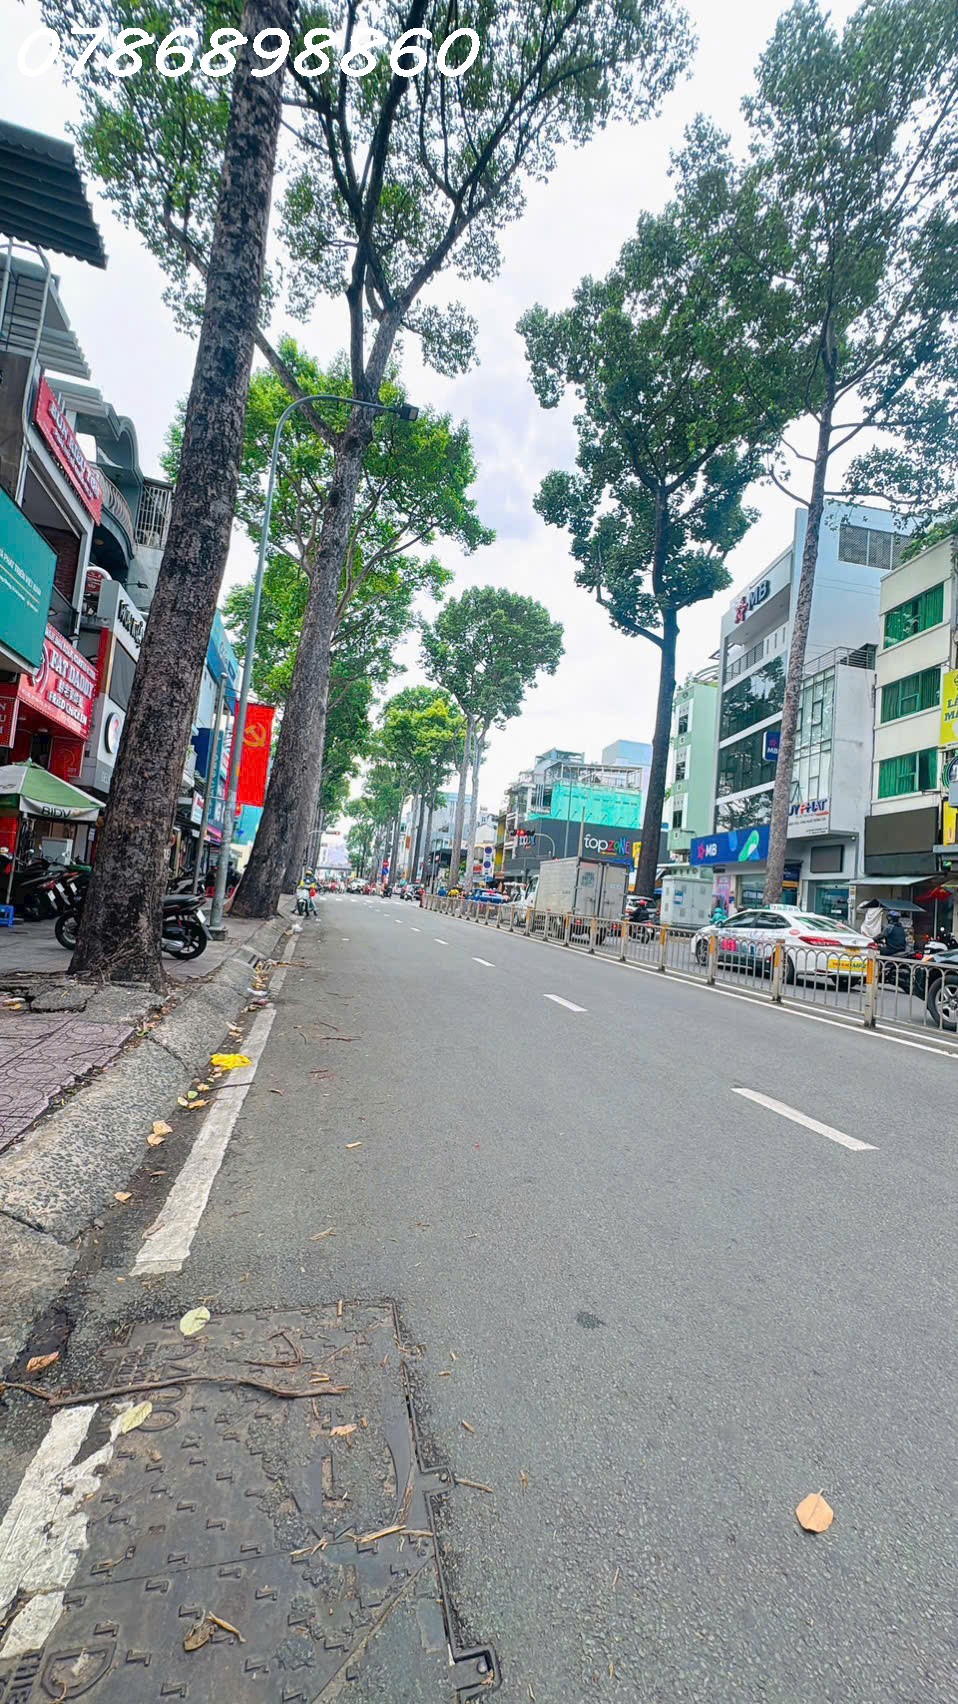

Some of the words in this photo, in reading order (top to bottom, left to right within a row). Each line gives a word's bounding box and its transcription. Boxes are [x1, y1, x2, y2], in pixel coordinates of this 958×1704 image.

[749, 580, 770, 610] MB
[69, 666, 94, 699] DADDY
[48, 691, 65, 709] FRIED
[65, 704, 88, 725] CHICKEN
[41, 806, 72, 818] BIDV
[705, 843, 718, 856] MB
